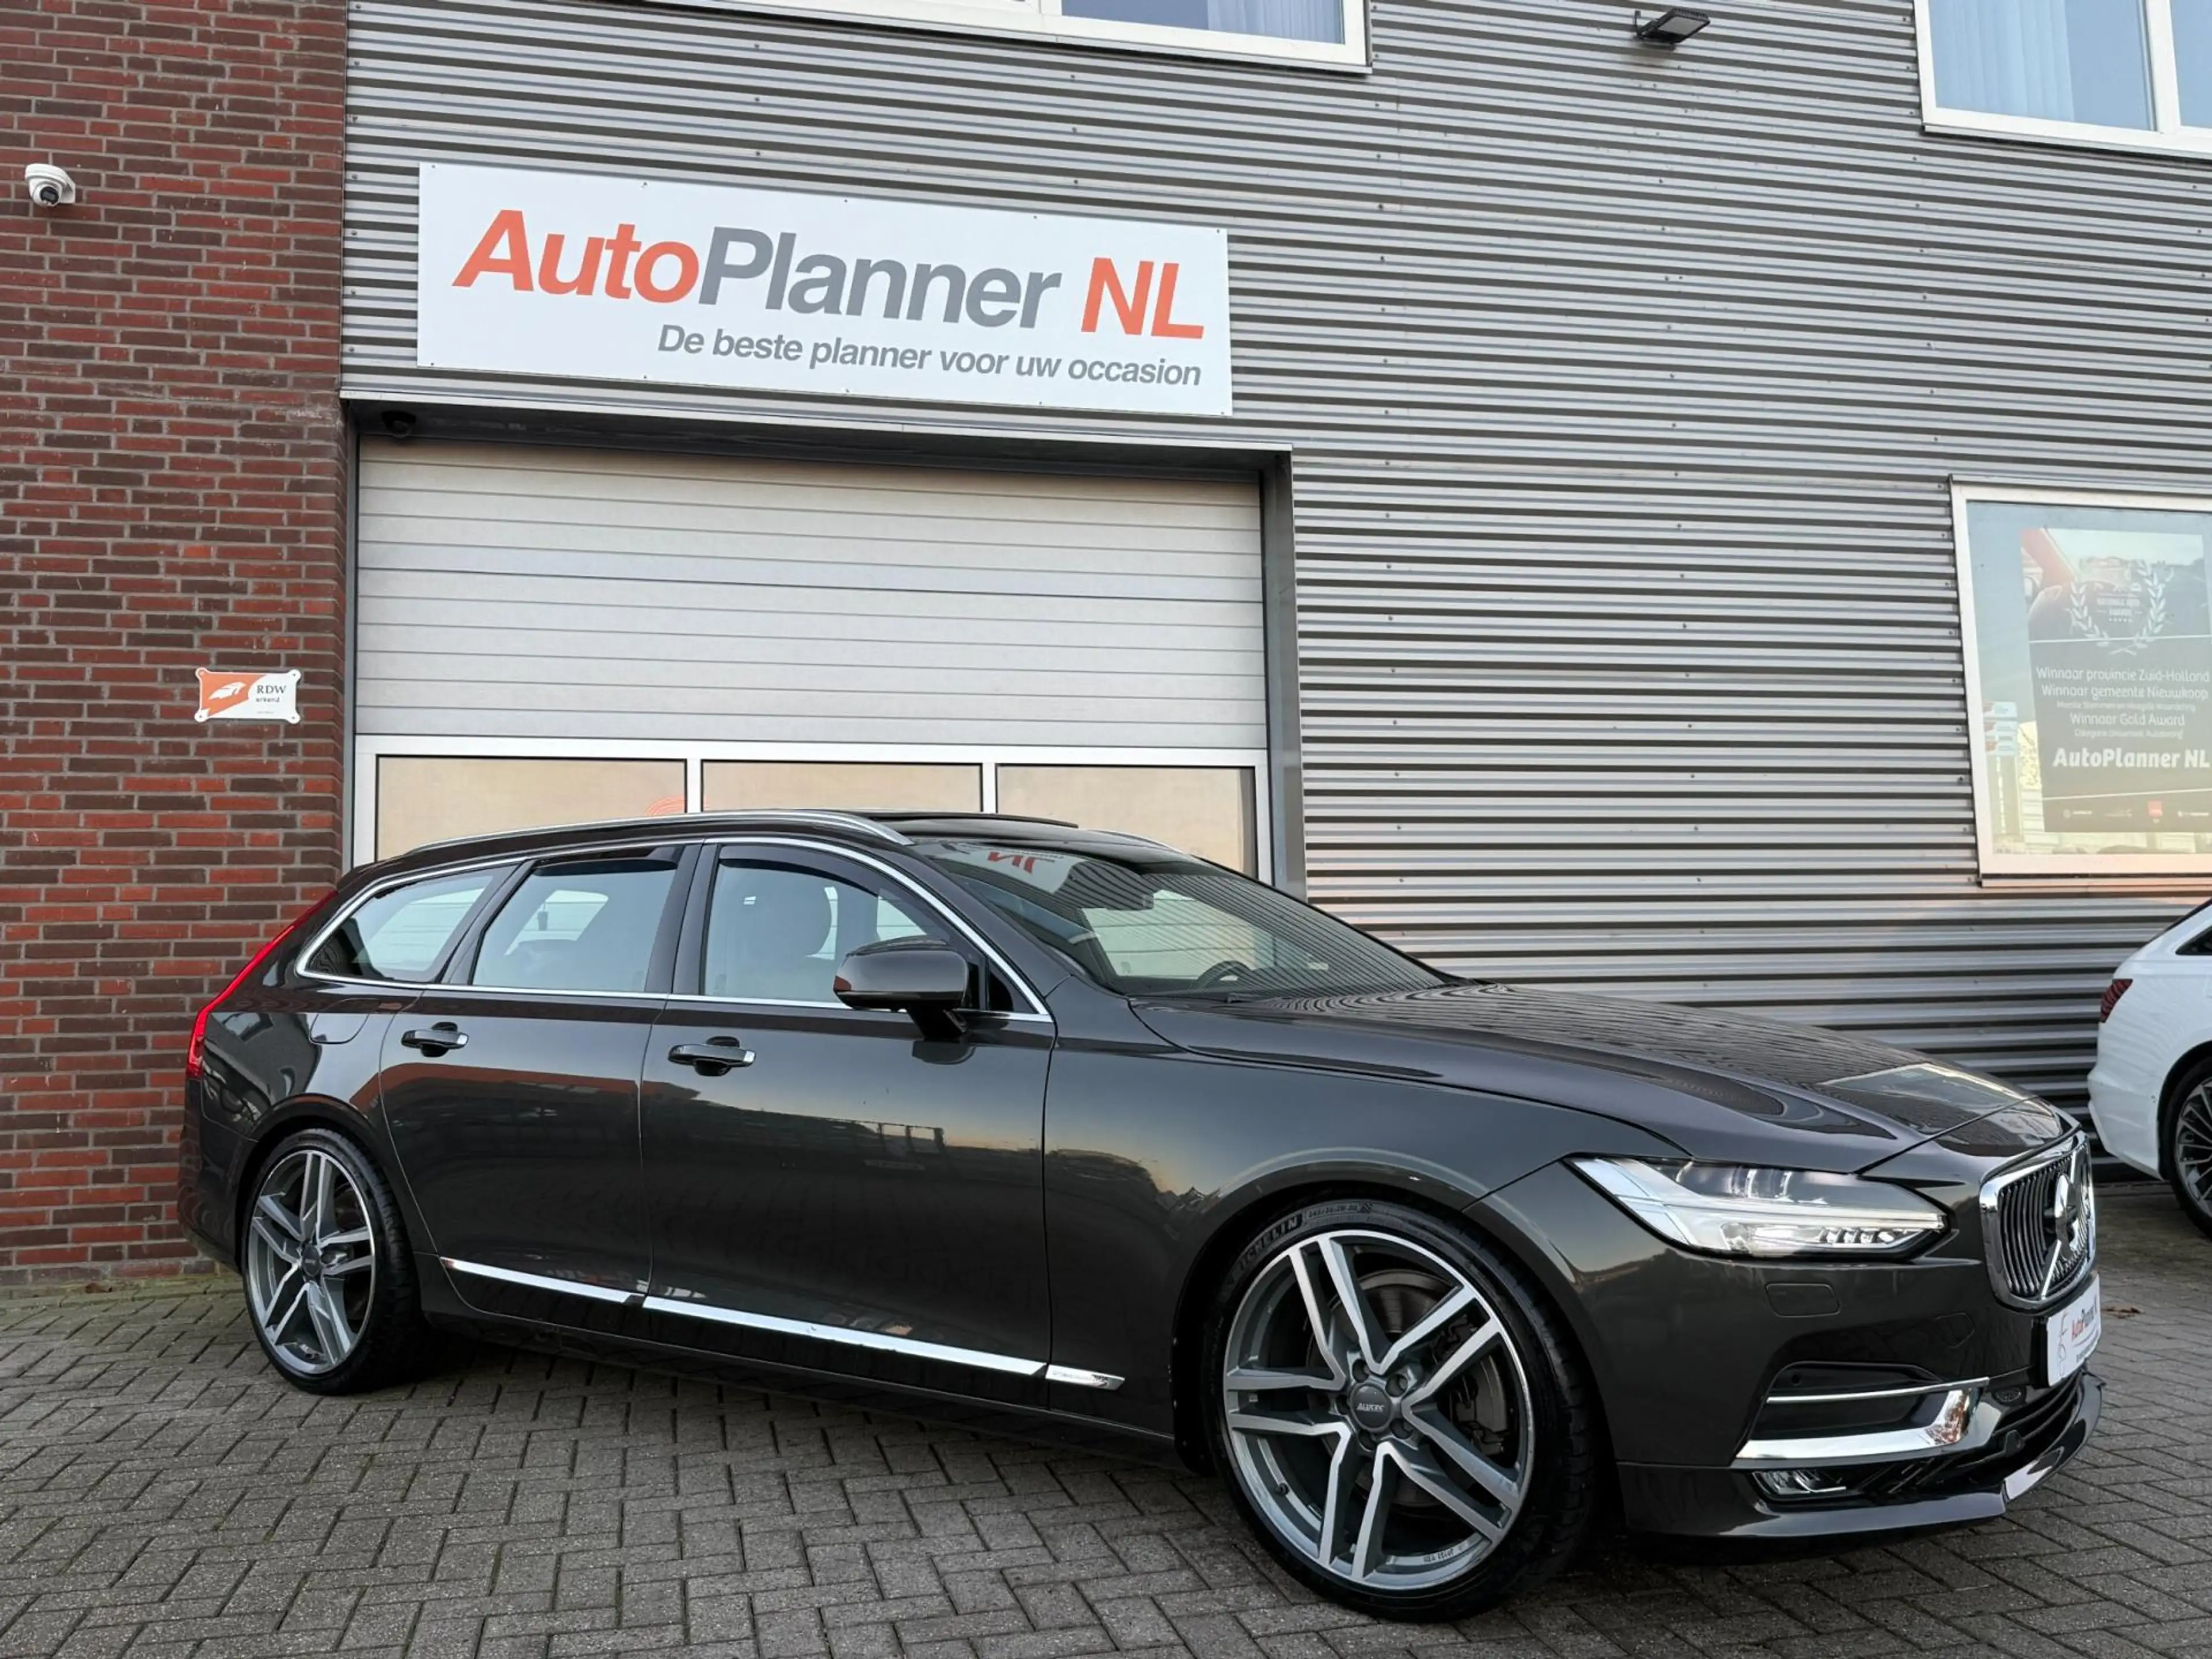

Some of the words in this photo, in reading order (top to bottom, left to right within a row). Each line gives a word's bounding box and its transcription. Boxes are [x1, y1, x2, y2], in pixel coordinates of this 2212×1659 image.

[452, 209, 1062, 329] AutoPlanner
[1081, 257, 1204, 339] NL
[658, 324, 704, 354] De
[713, 328, 803, 361] beste
[809, 338, 931, 369] planner
[940, 350, 1009, 374] voor
[1016, 355, 1062, 378] uw
[1068, 358, 1202, 386] occasion
[2036, 666, 2084, 680] Winnaar
[2086, 668, 2136, 683] provincie
[2139, 669, 2210, 683] Zuid-Holland
[256, 685, 286, 694] RDW
[2041, 684, 2088, 697] Winnaar
[2091, 686, 2145, 700] gemeente
[2147, 686, 2209, 700] Nieuwkoop
[2069, 712, 2118, 725] Winnaar
[2120, 713, 2146, 726] Gold
[2148, 714, 2185, 726] Award
[2052, 747, 2180, 768] AutoPlanner
[2184, 748, 2211, 768] NL
